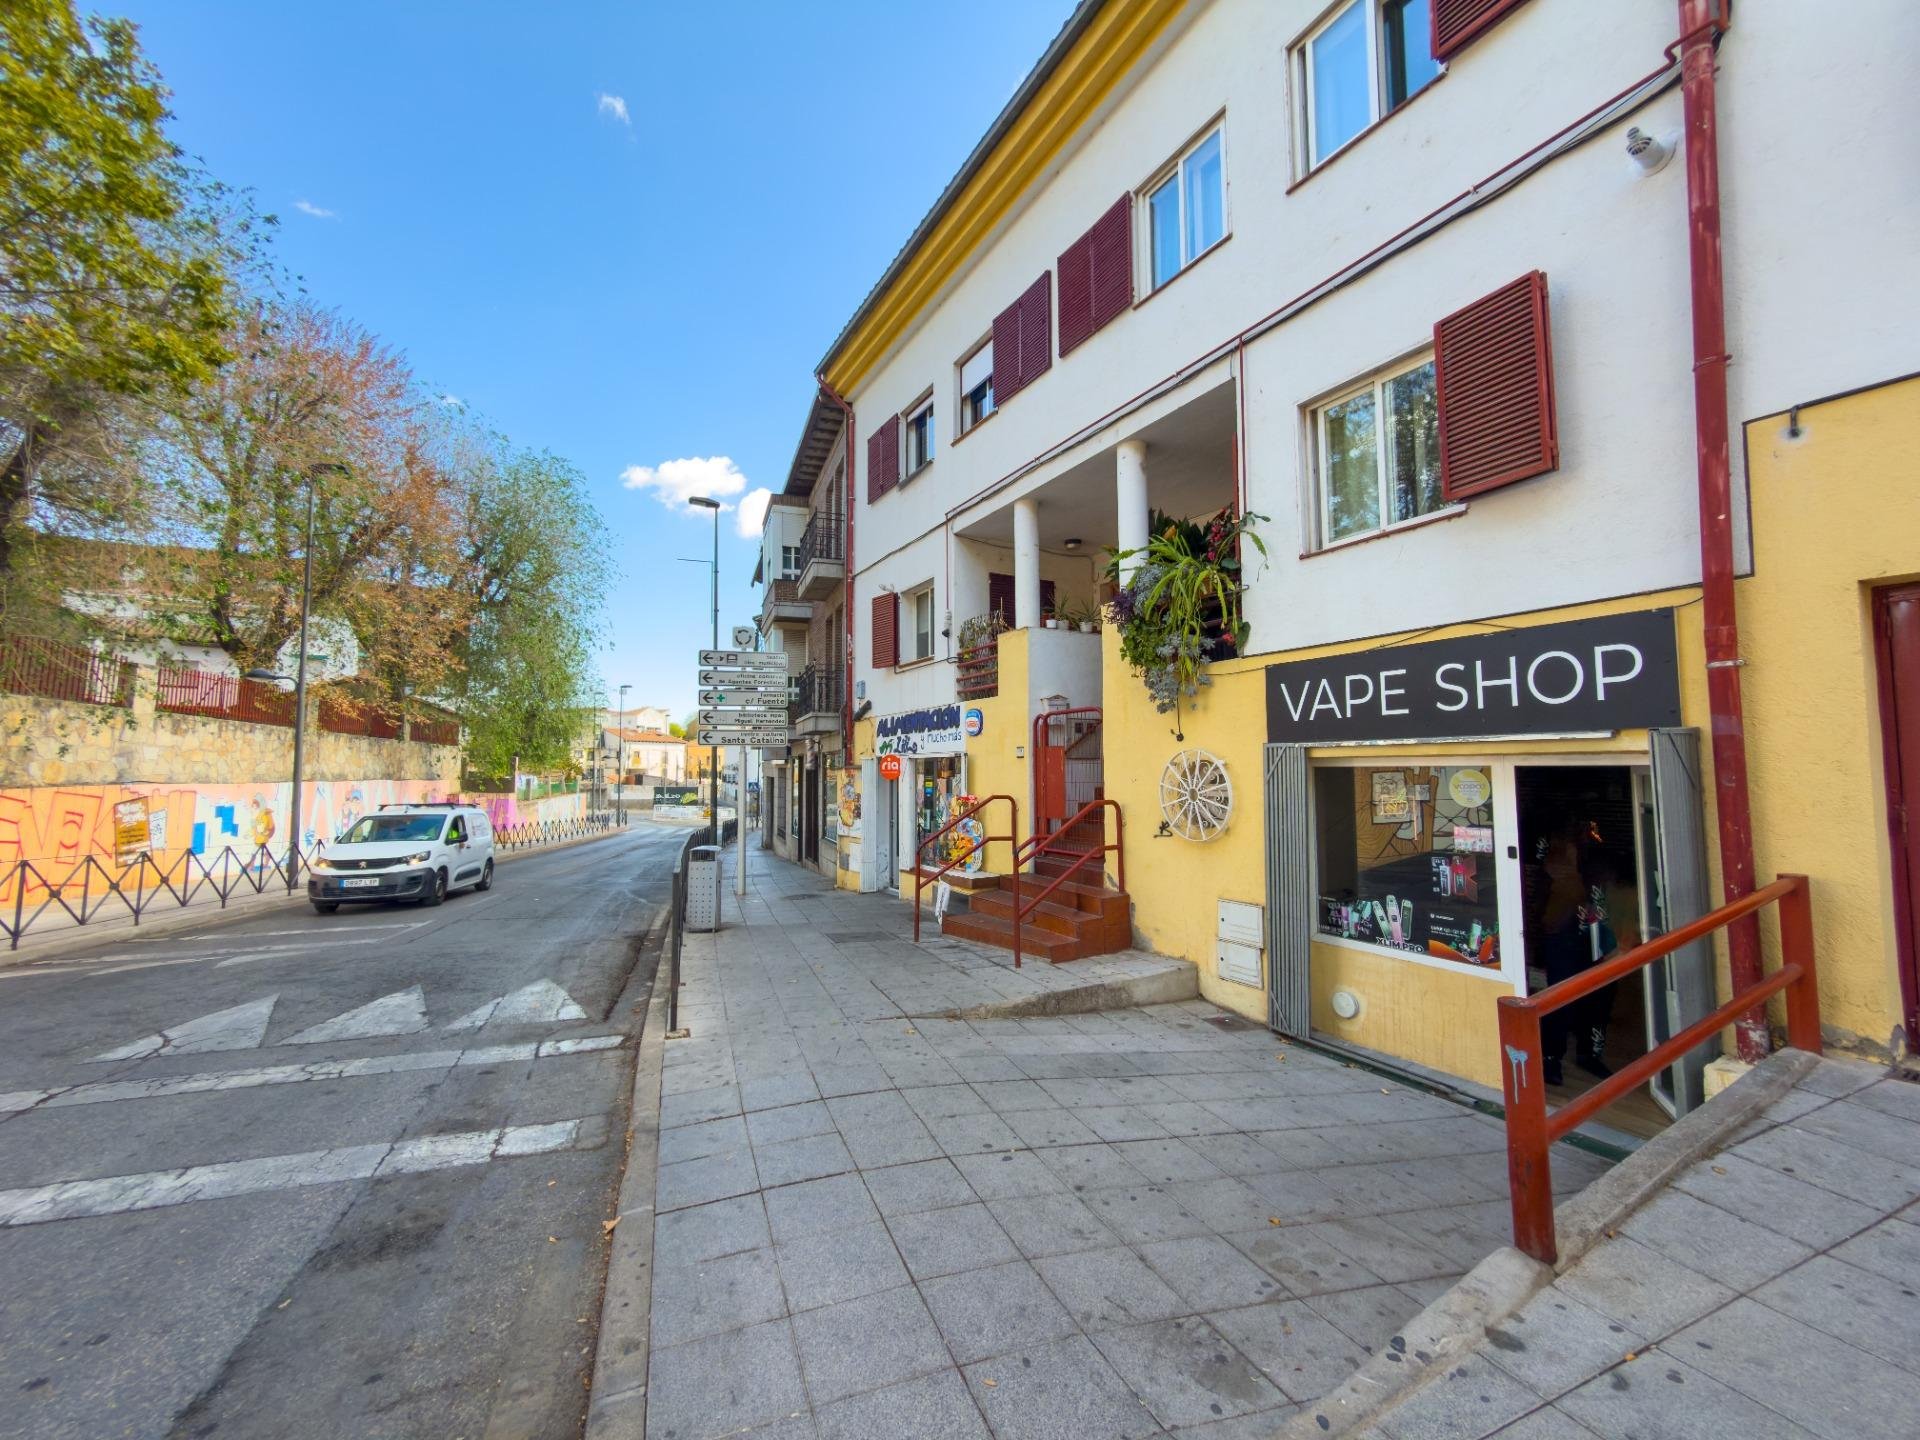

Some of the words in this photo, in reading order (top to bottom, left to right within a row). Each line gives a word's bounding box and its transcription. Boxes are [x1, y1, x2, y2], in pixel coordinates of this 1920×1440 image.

[1280, 669, 1410, 722] VAPE
[1434, 643, 1643, 712] SHOP
[920, 734, 925, 750] y
[928, 732, 946, 743] mucho
[882, 758, 898, 770] ria
[1376, 936, 1402, 950] XLIM
[1402, 942, 1424, 953] PRO
